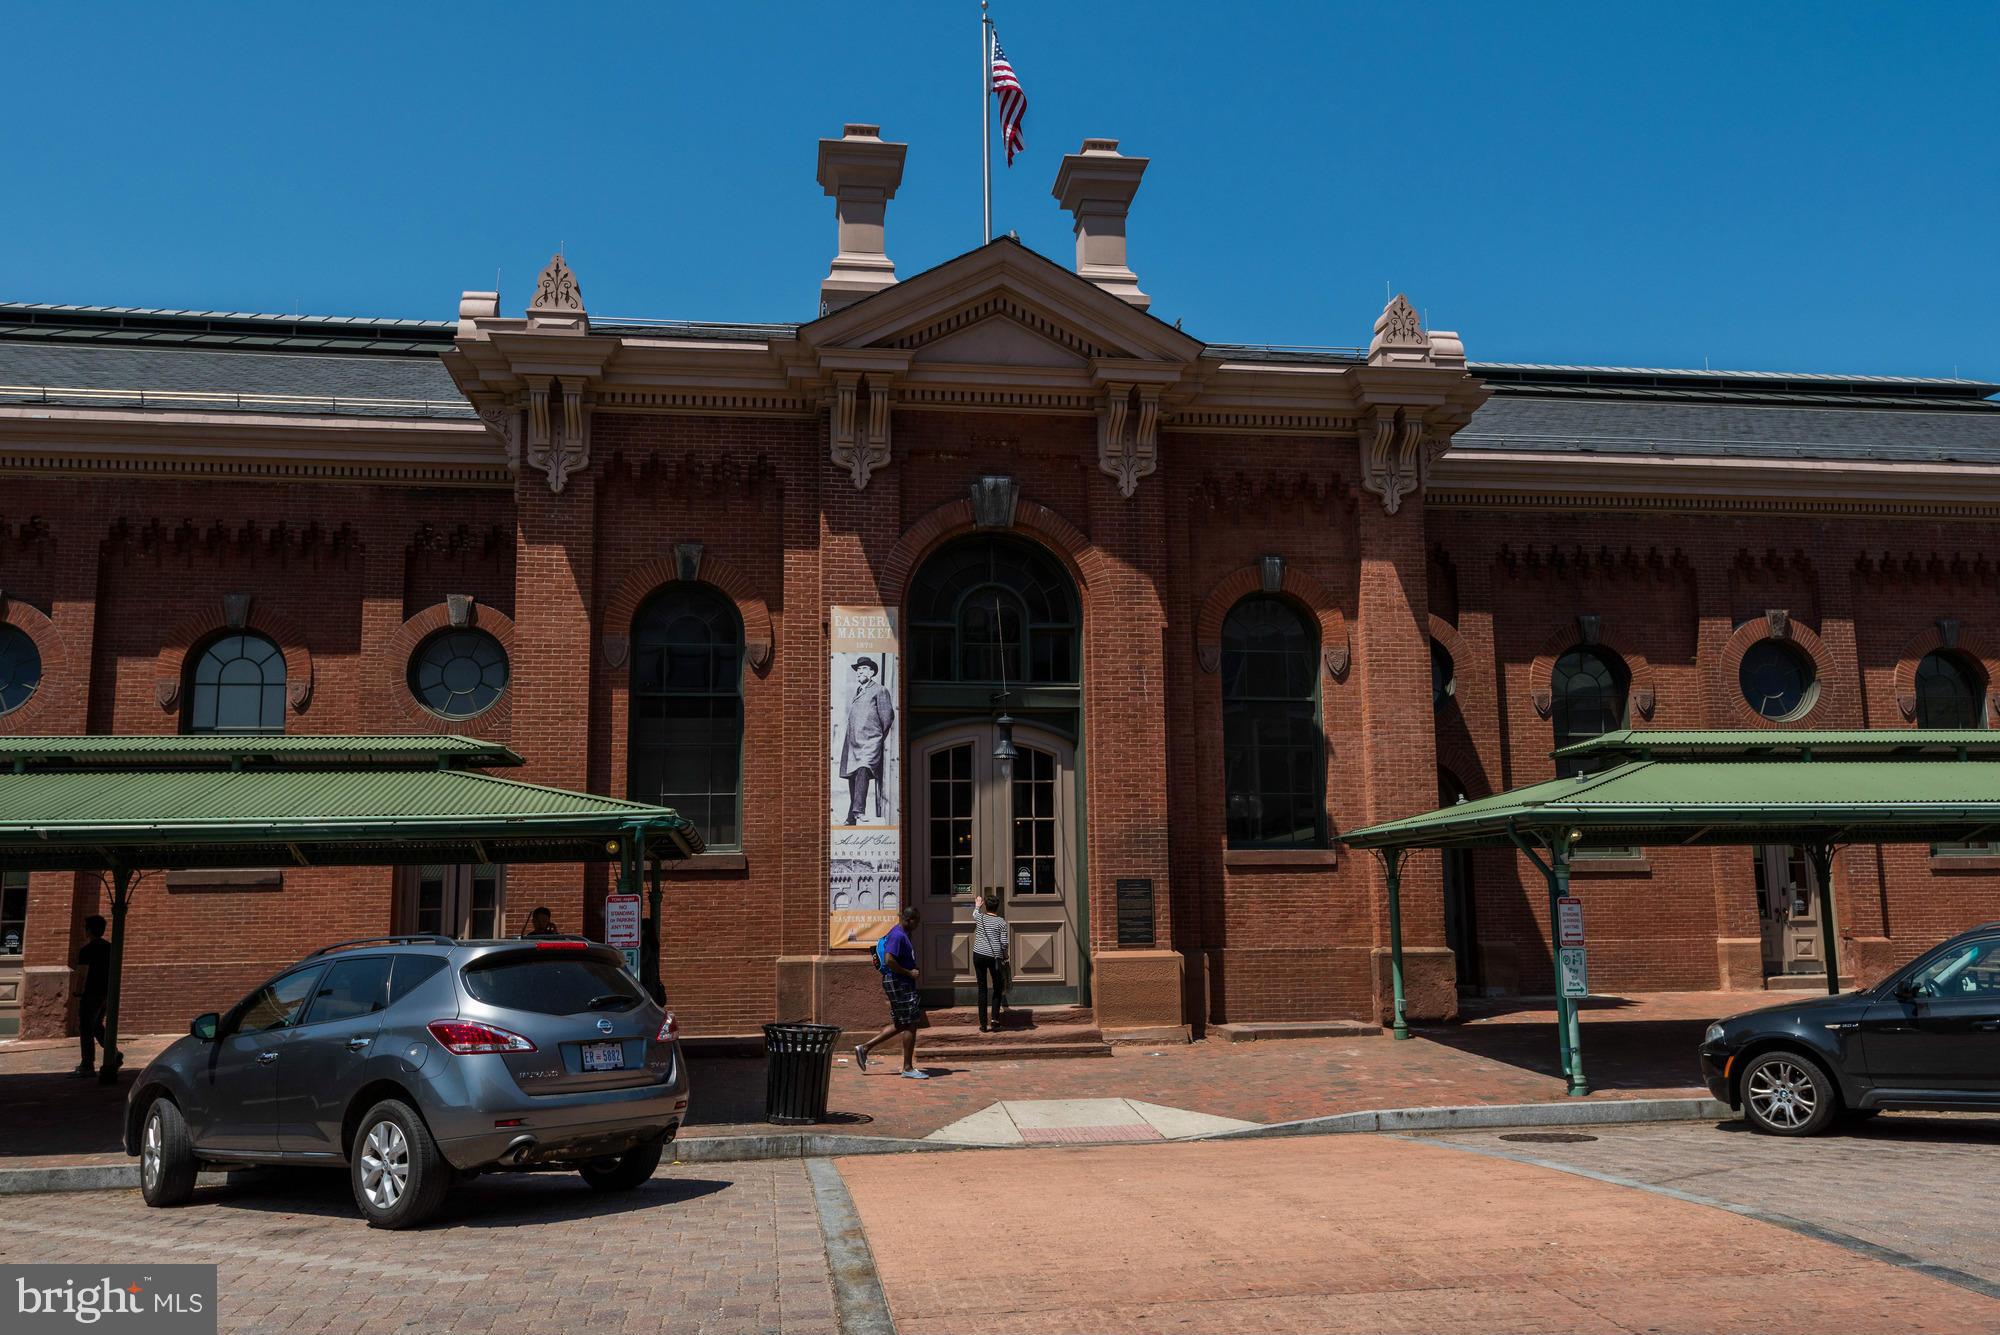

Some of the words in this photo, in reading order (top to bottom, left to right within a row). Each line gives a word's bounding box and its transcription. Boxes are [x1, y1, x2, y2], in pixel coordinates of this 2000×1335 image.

[835, 615, 894, 627] EASTERN
[838, 627, 893, 639] MARKET
[584, 1051, 595, 1063] ER
